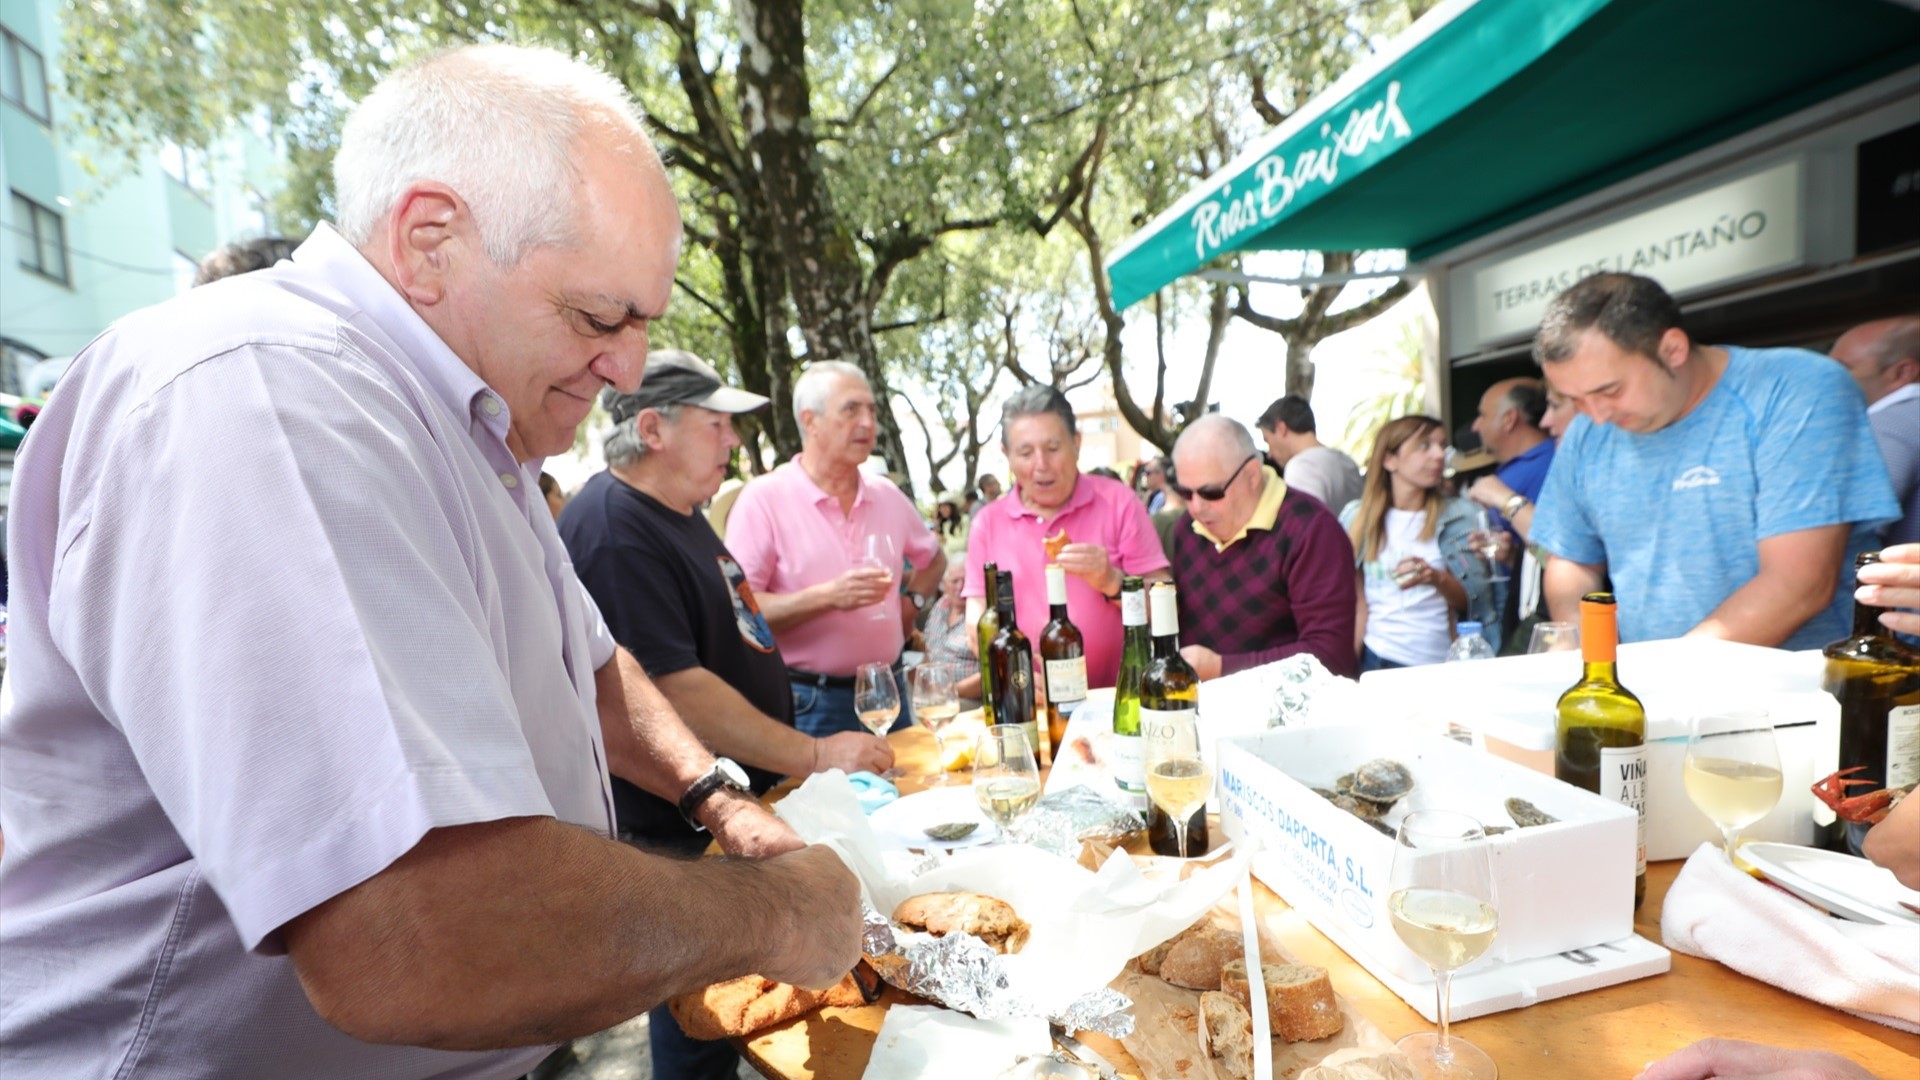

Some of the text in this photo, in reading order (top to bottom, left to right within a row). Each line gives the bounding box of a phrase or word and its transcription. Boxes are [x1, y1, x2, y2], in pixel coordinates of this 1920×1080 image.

[1255, 81, 1412, 218] Baixas
[1492, 270, 1570, 311] TERRAS
[1222, 767, 1274, 822] MARISCOS
[1278, 808, 1341, 878] DAPORTA,
[1345, 856, 1373, 898] S.L.
